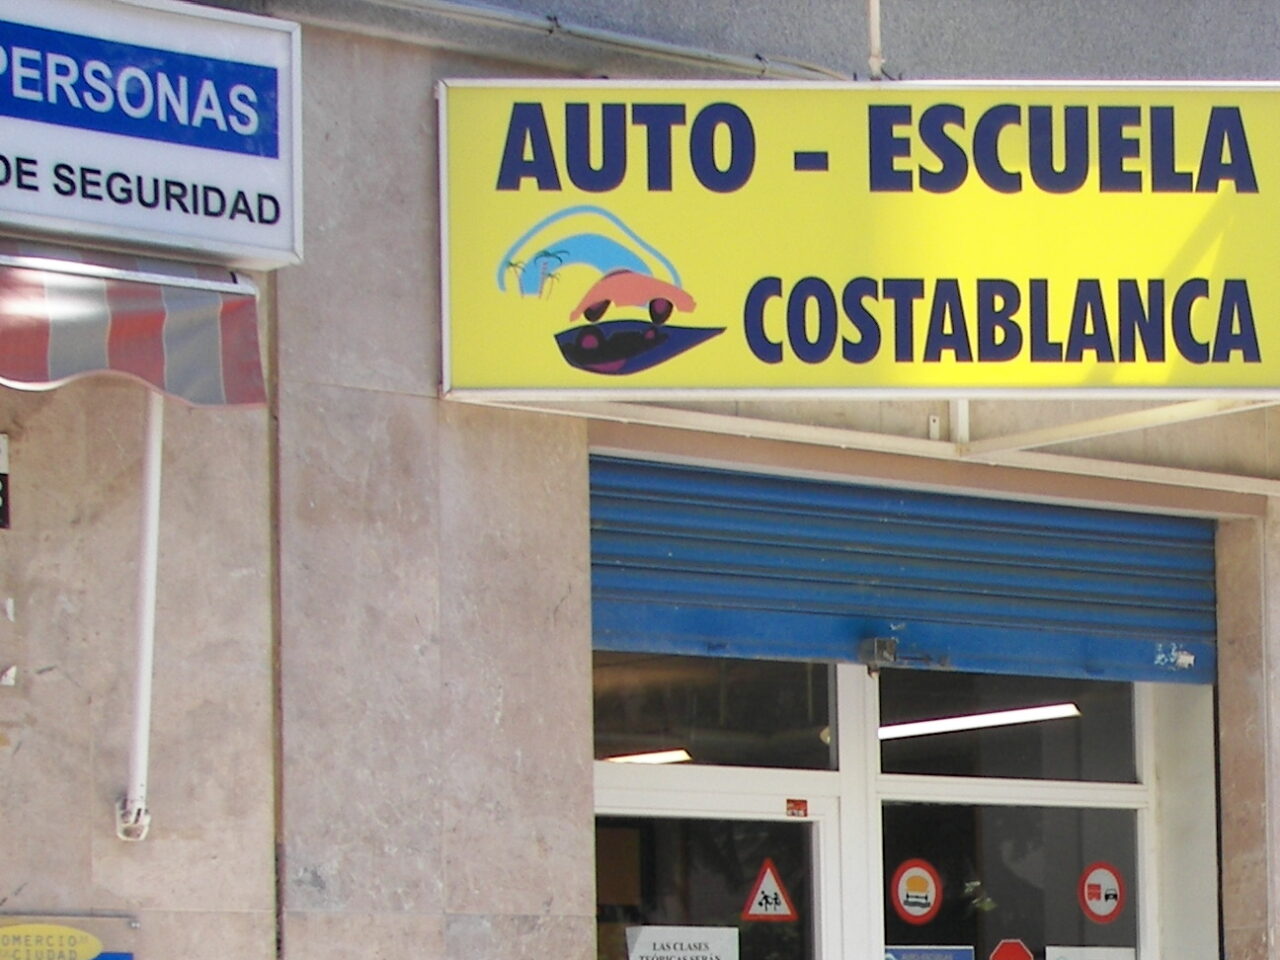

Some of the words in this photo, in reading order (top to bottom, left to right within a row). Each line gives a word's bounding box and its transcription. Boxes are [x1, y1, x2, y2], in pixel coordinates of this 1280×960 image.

[0, 44, 259, 136] ERSONAS
[496, 102, 756, 193] AUTO
[793, 151, 829, 171] -
[868, 104, 1259, 195] ESCUELA
[53, 163, 281, 225] SEGURIDAD
[743, 277, 1262, 365] COSTABLANCA
[13, 949, 77, 960] CIUDAD
[653, 942, 671, 951] LAS
[673, 942, 710, 951] CLASES
